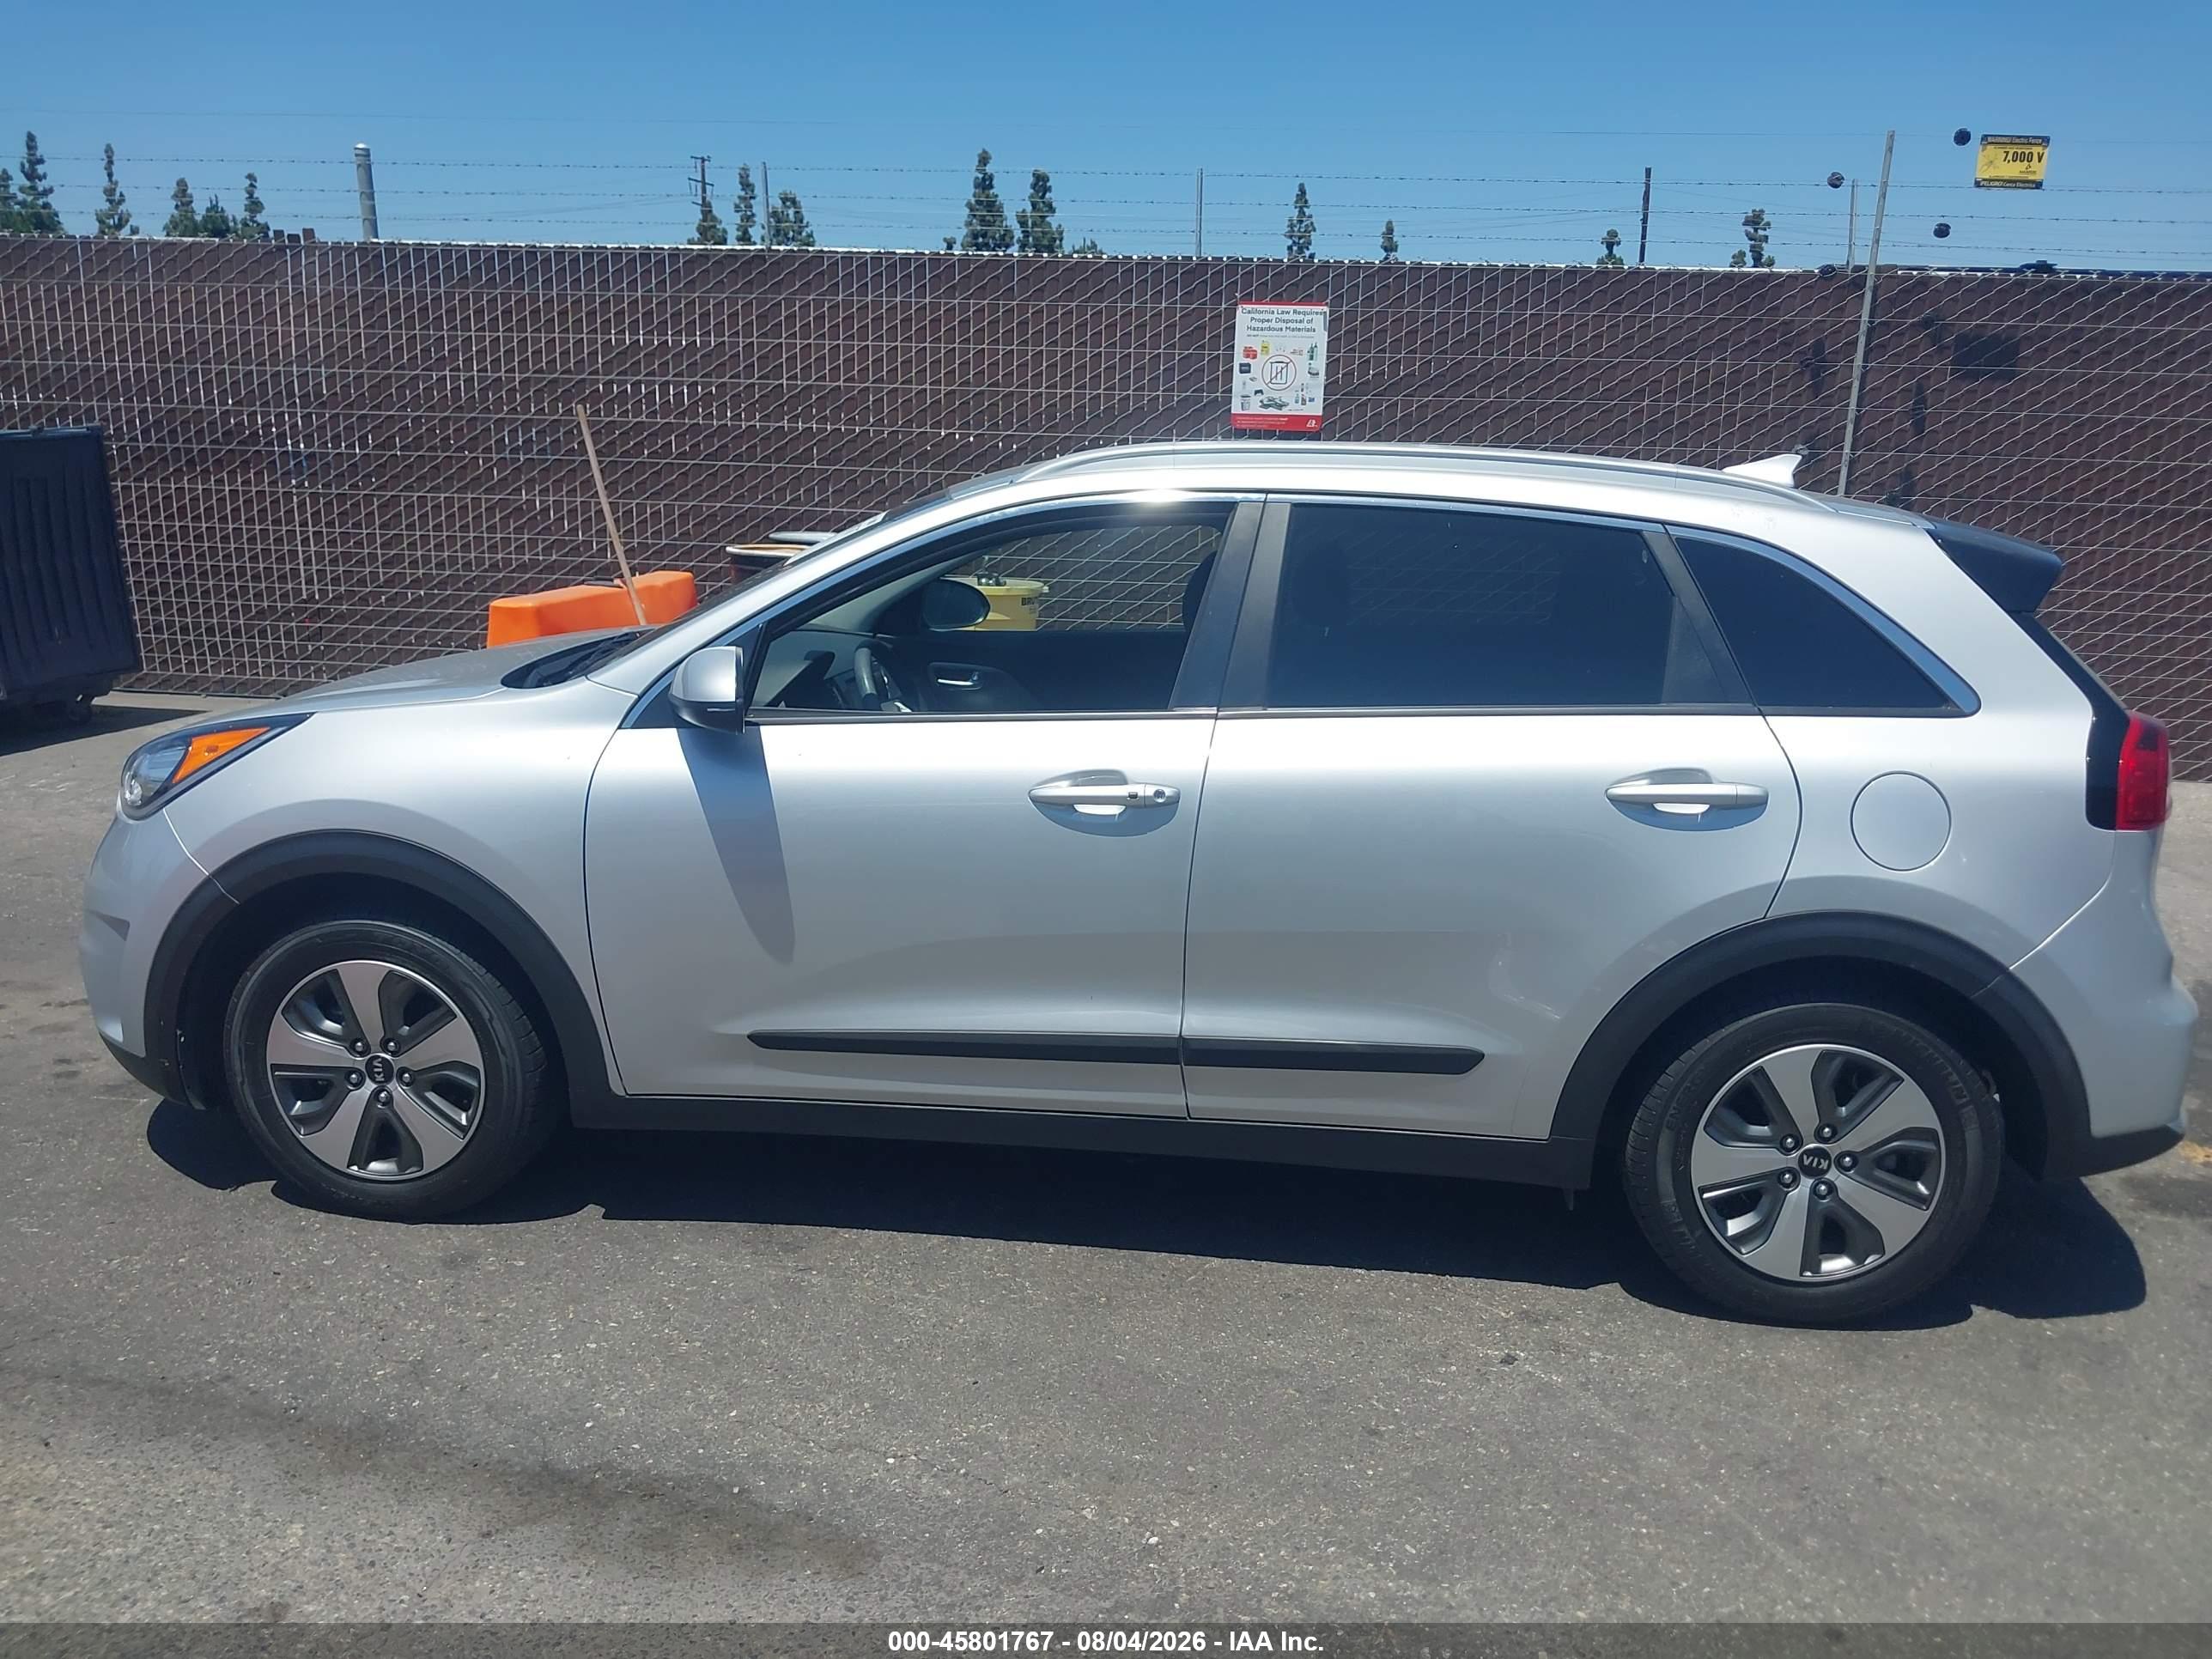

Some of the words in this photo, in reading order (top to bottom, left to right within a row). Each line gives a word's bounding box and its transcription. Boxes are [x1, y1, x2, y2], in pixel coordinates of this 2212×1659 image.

[2002, 150, 2033, 164] 7,000
[2037, 151, 2045, 163] V
[373, 1058, 385, 1082] KIA
[1802, 1153, 1830, 1170] KIA
